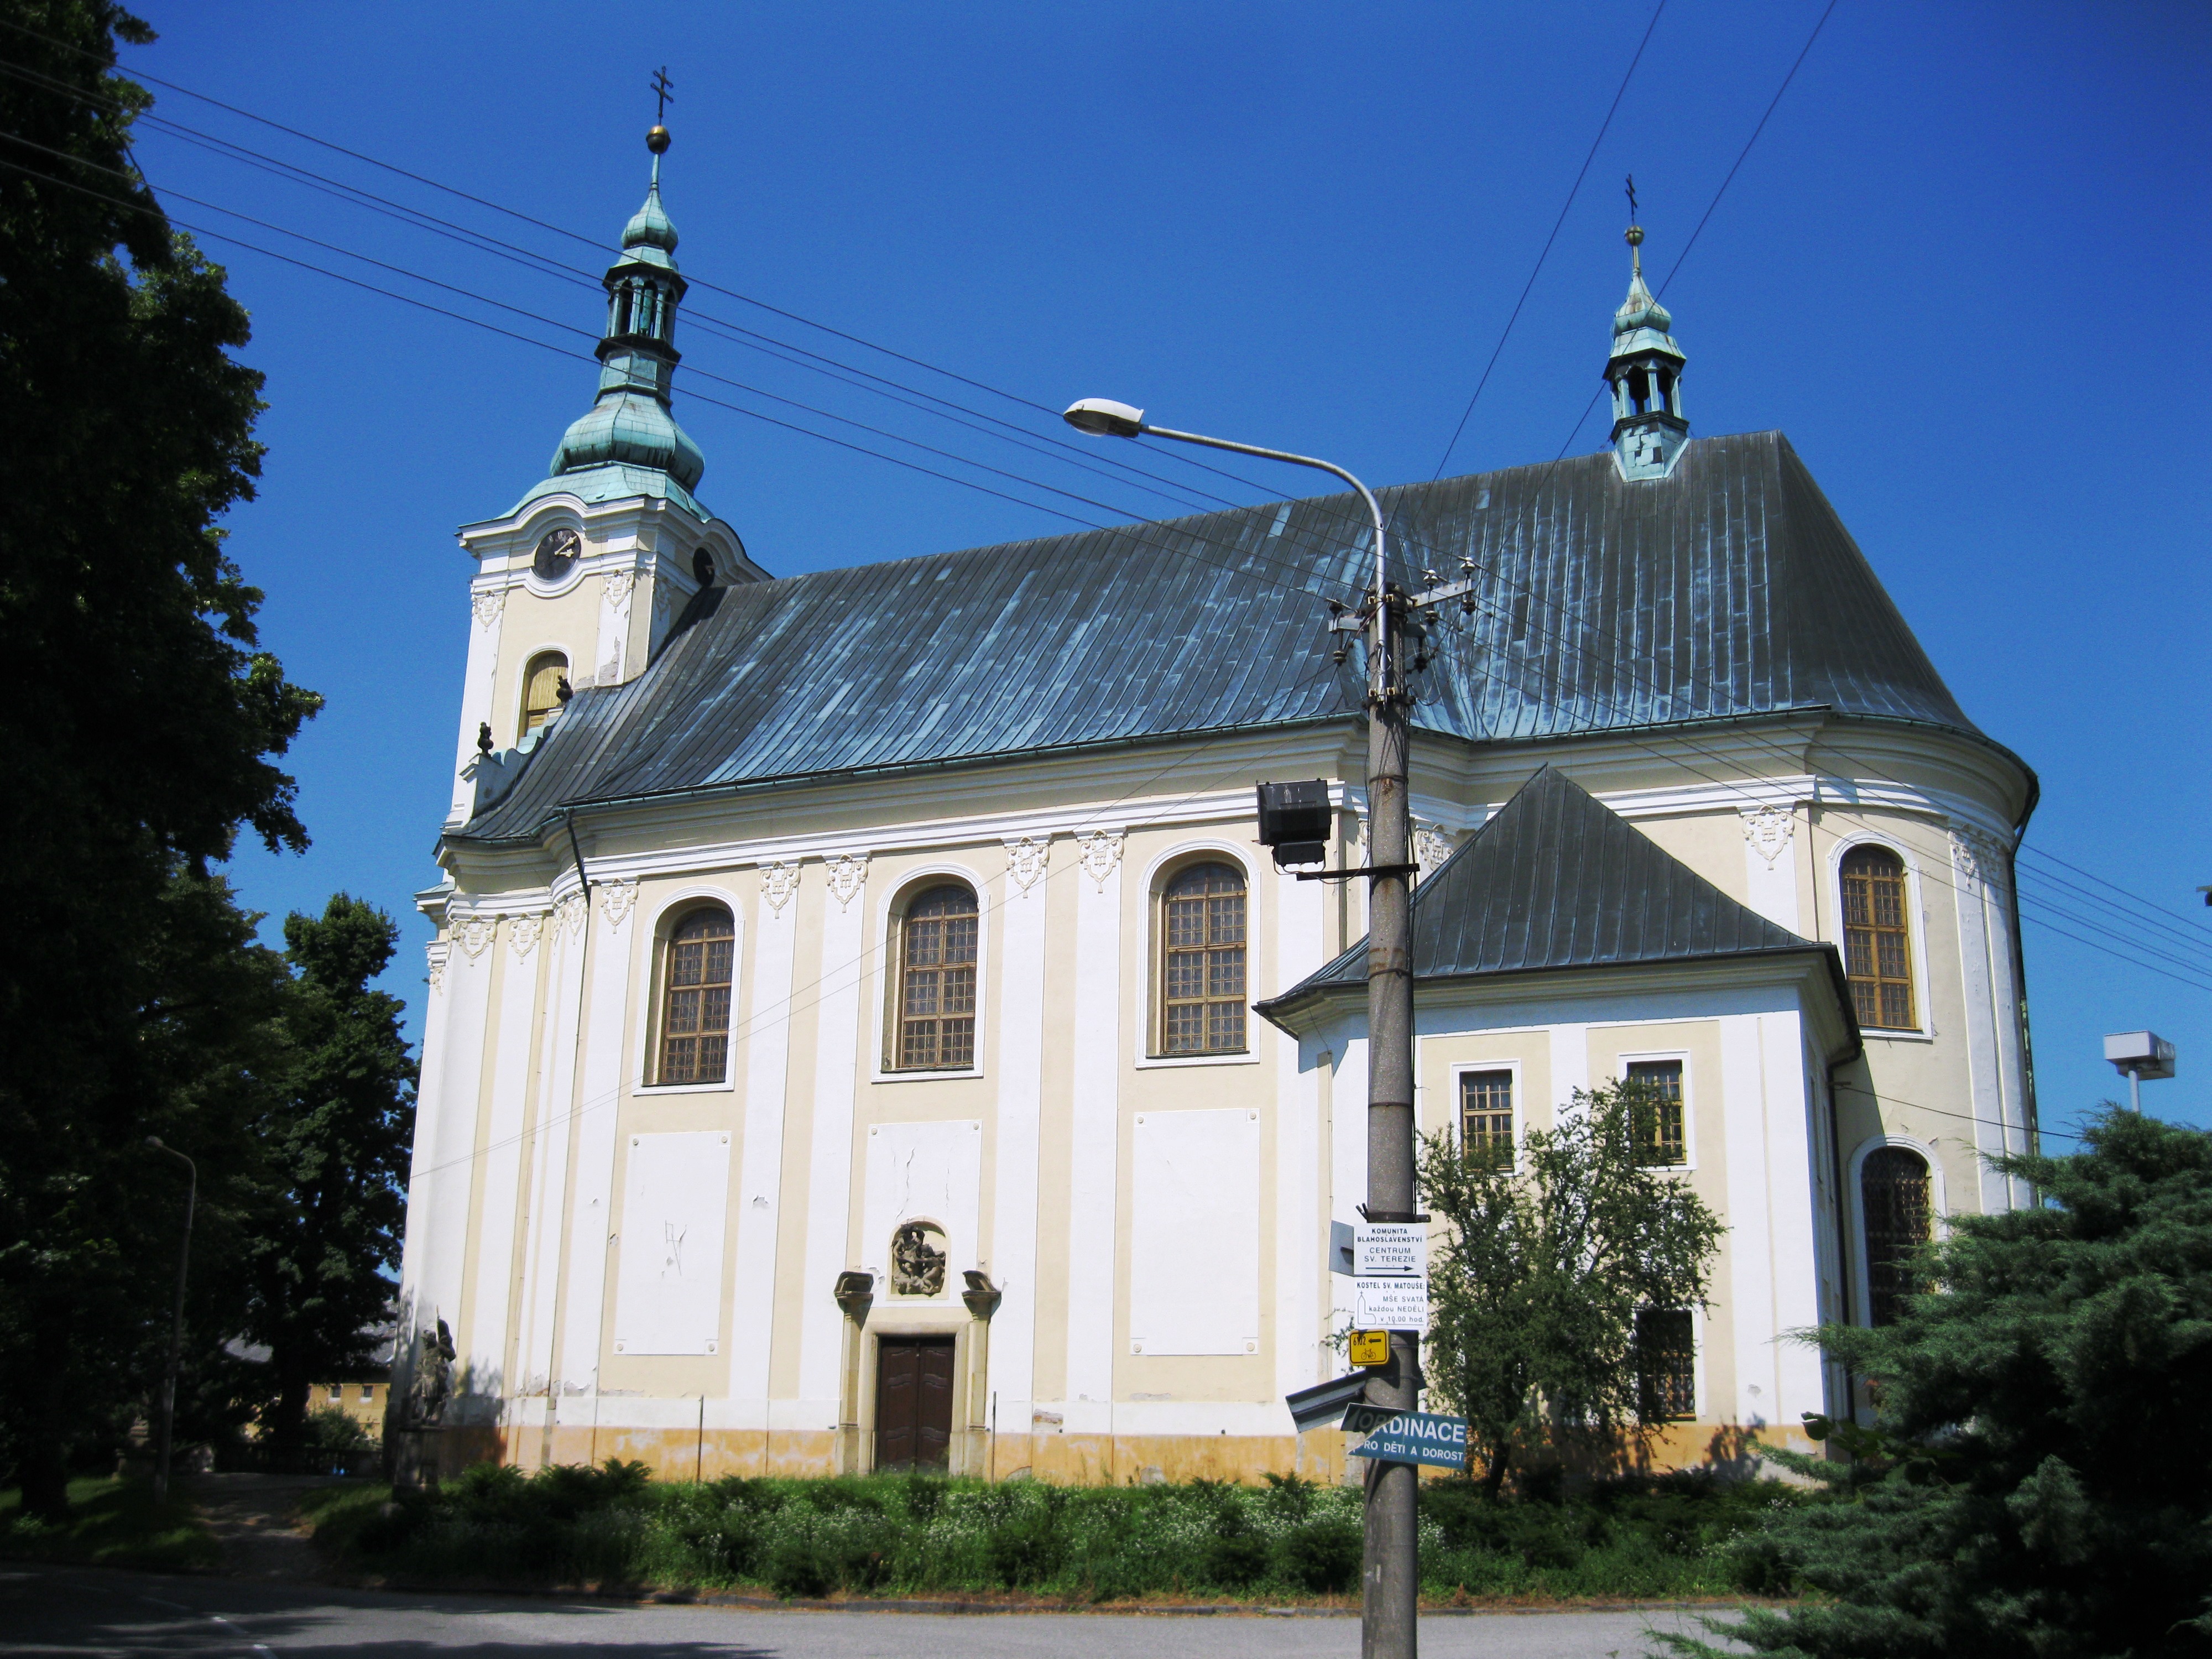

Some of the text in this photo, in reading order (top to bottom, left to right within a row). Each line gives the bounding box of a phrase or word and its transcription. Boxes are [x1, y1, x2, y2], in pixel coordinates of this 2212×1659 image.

[1394, 1280, 1425, 1290] MATOUŠE:
[1383, 1294, 1398, 1302] MŠE
[1384, 1441, 1405, 1454] DĚTI
[1410, 1446, 1417, 1456] A
[1422, 1447, 1464, 1462] DOROST
